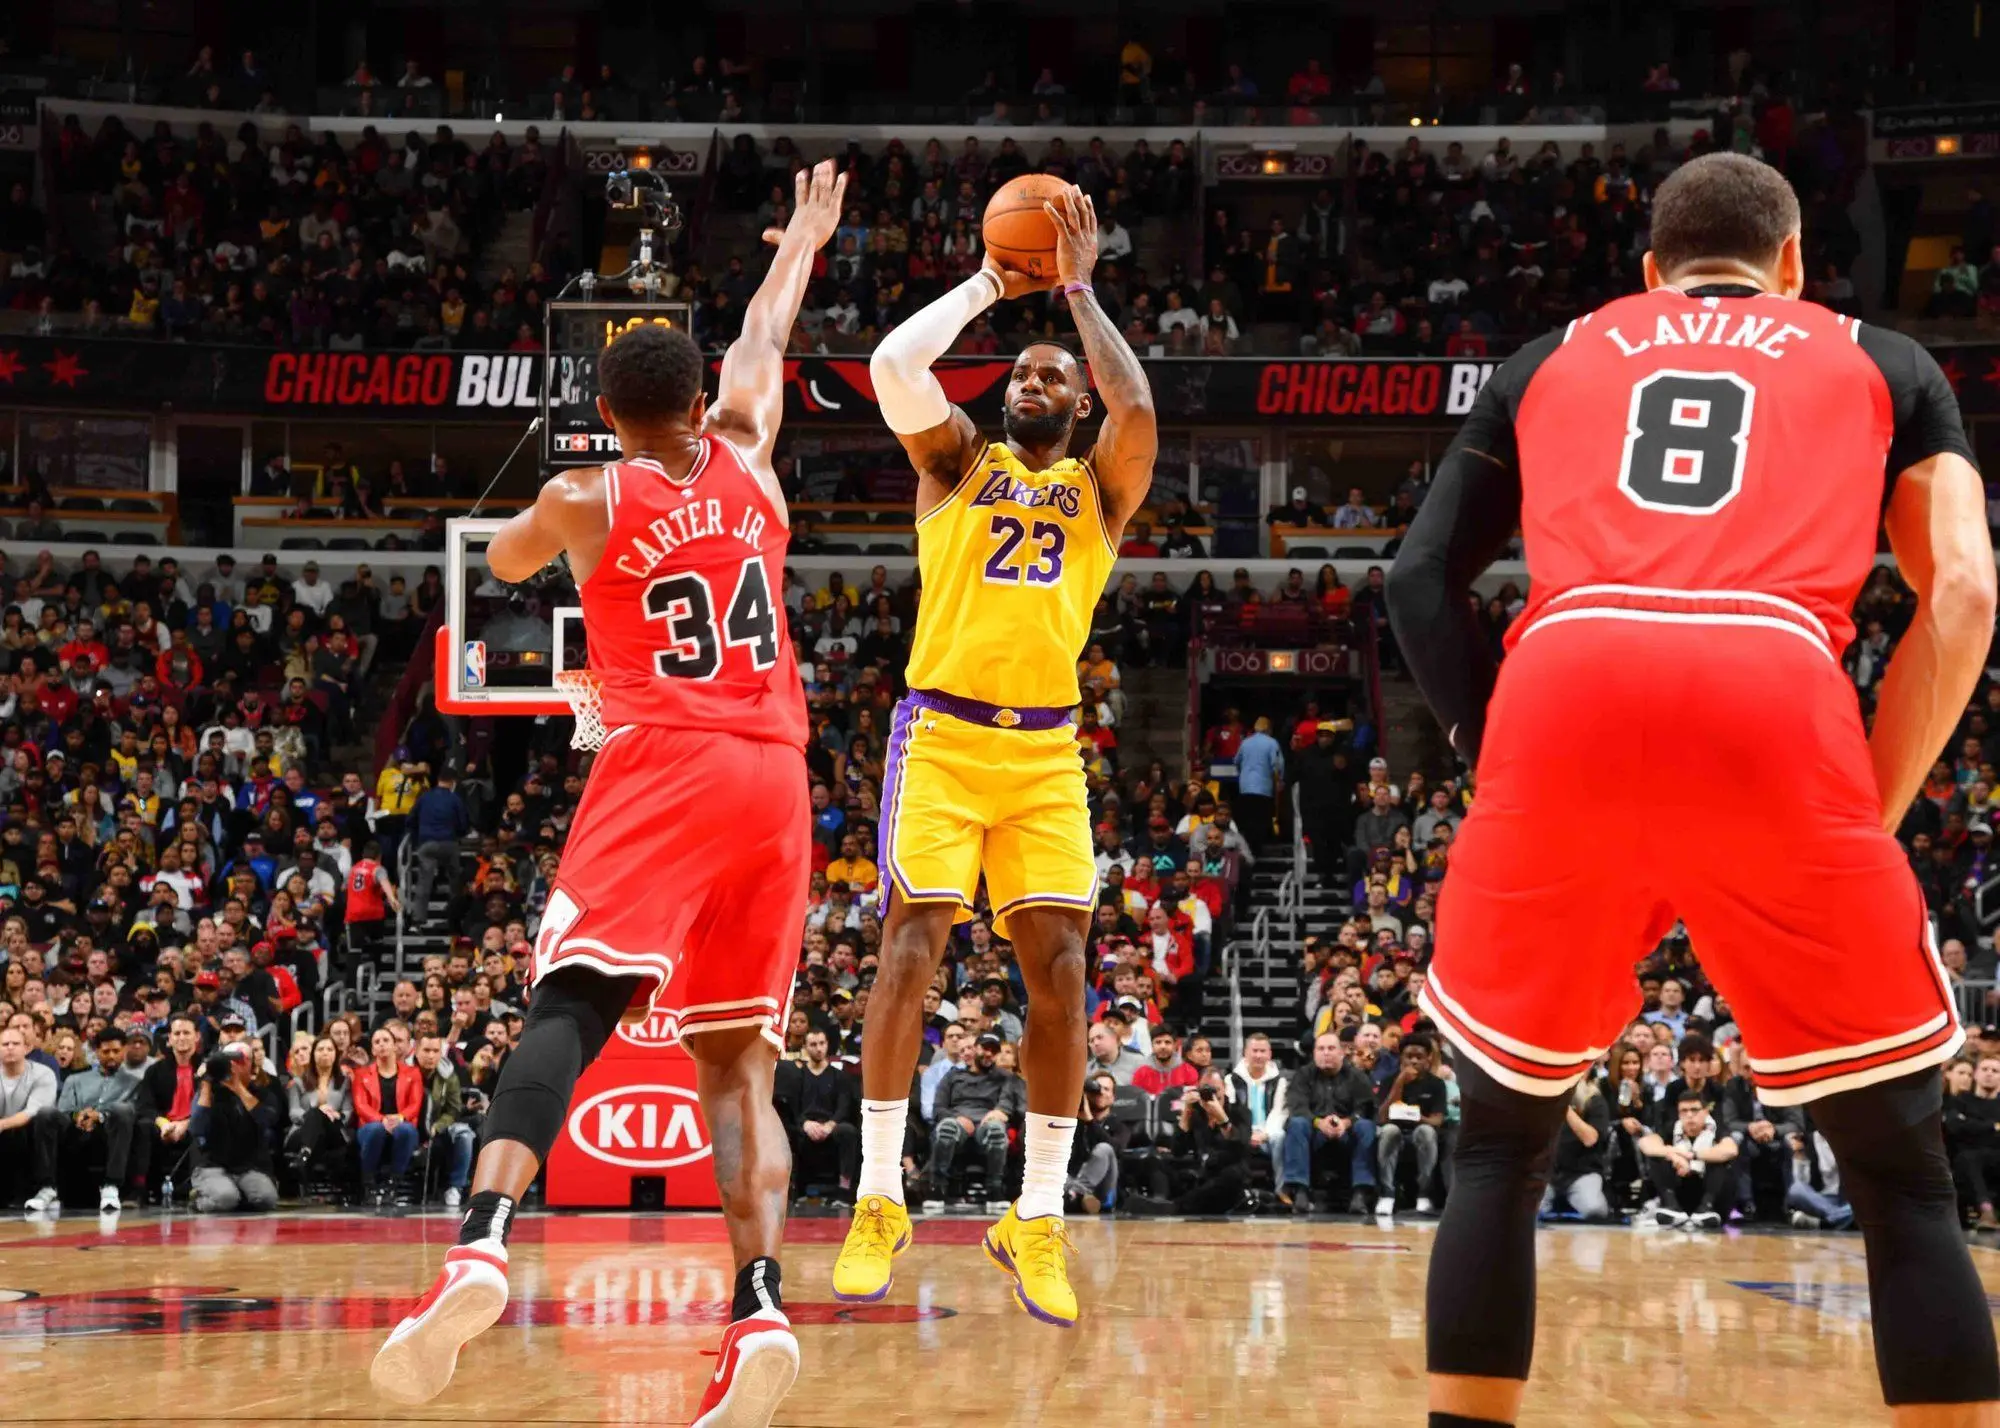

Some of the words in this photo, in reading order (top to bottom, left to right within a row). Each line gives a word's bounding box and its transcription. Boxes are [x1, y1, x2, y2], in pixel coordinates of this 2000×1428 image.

[1293, 156, 1327, 173] 210
[1605, 312, 1811, 360] LAVINE
[264, 353, 453, 406] CHICAGO
[1256, 363, 1441, 416] CHICAGO
[1617, 368, 1756, 516] 8
[968, 468, 1082, 519] LAKERS
[616, 498, 725, 580] CARTER
[983, 515, 1067, 588] 23
[641, 554, 779, 684] 34
[1220, 651, 1261, 672] 106
[1304, 651, 1341, 672] 107
[629, 1015, 680, 1039] KIA
[597, 1103, 703, 1149] KIA
